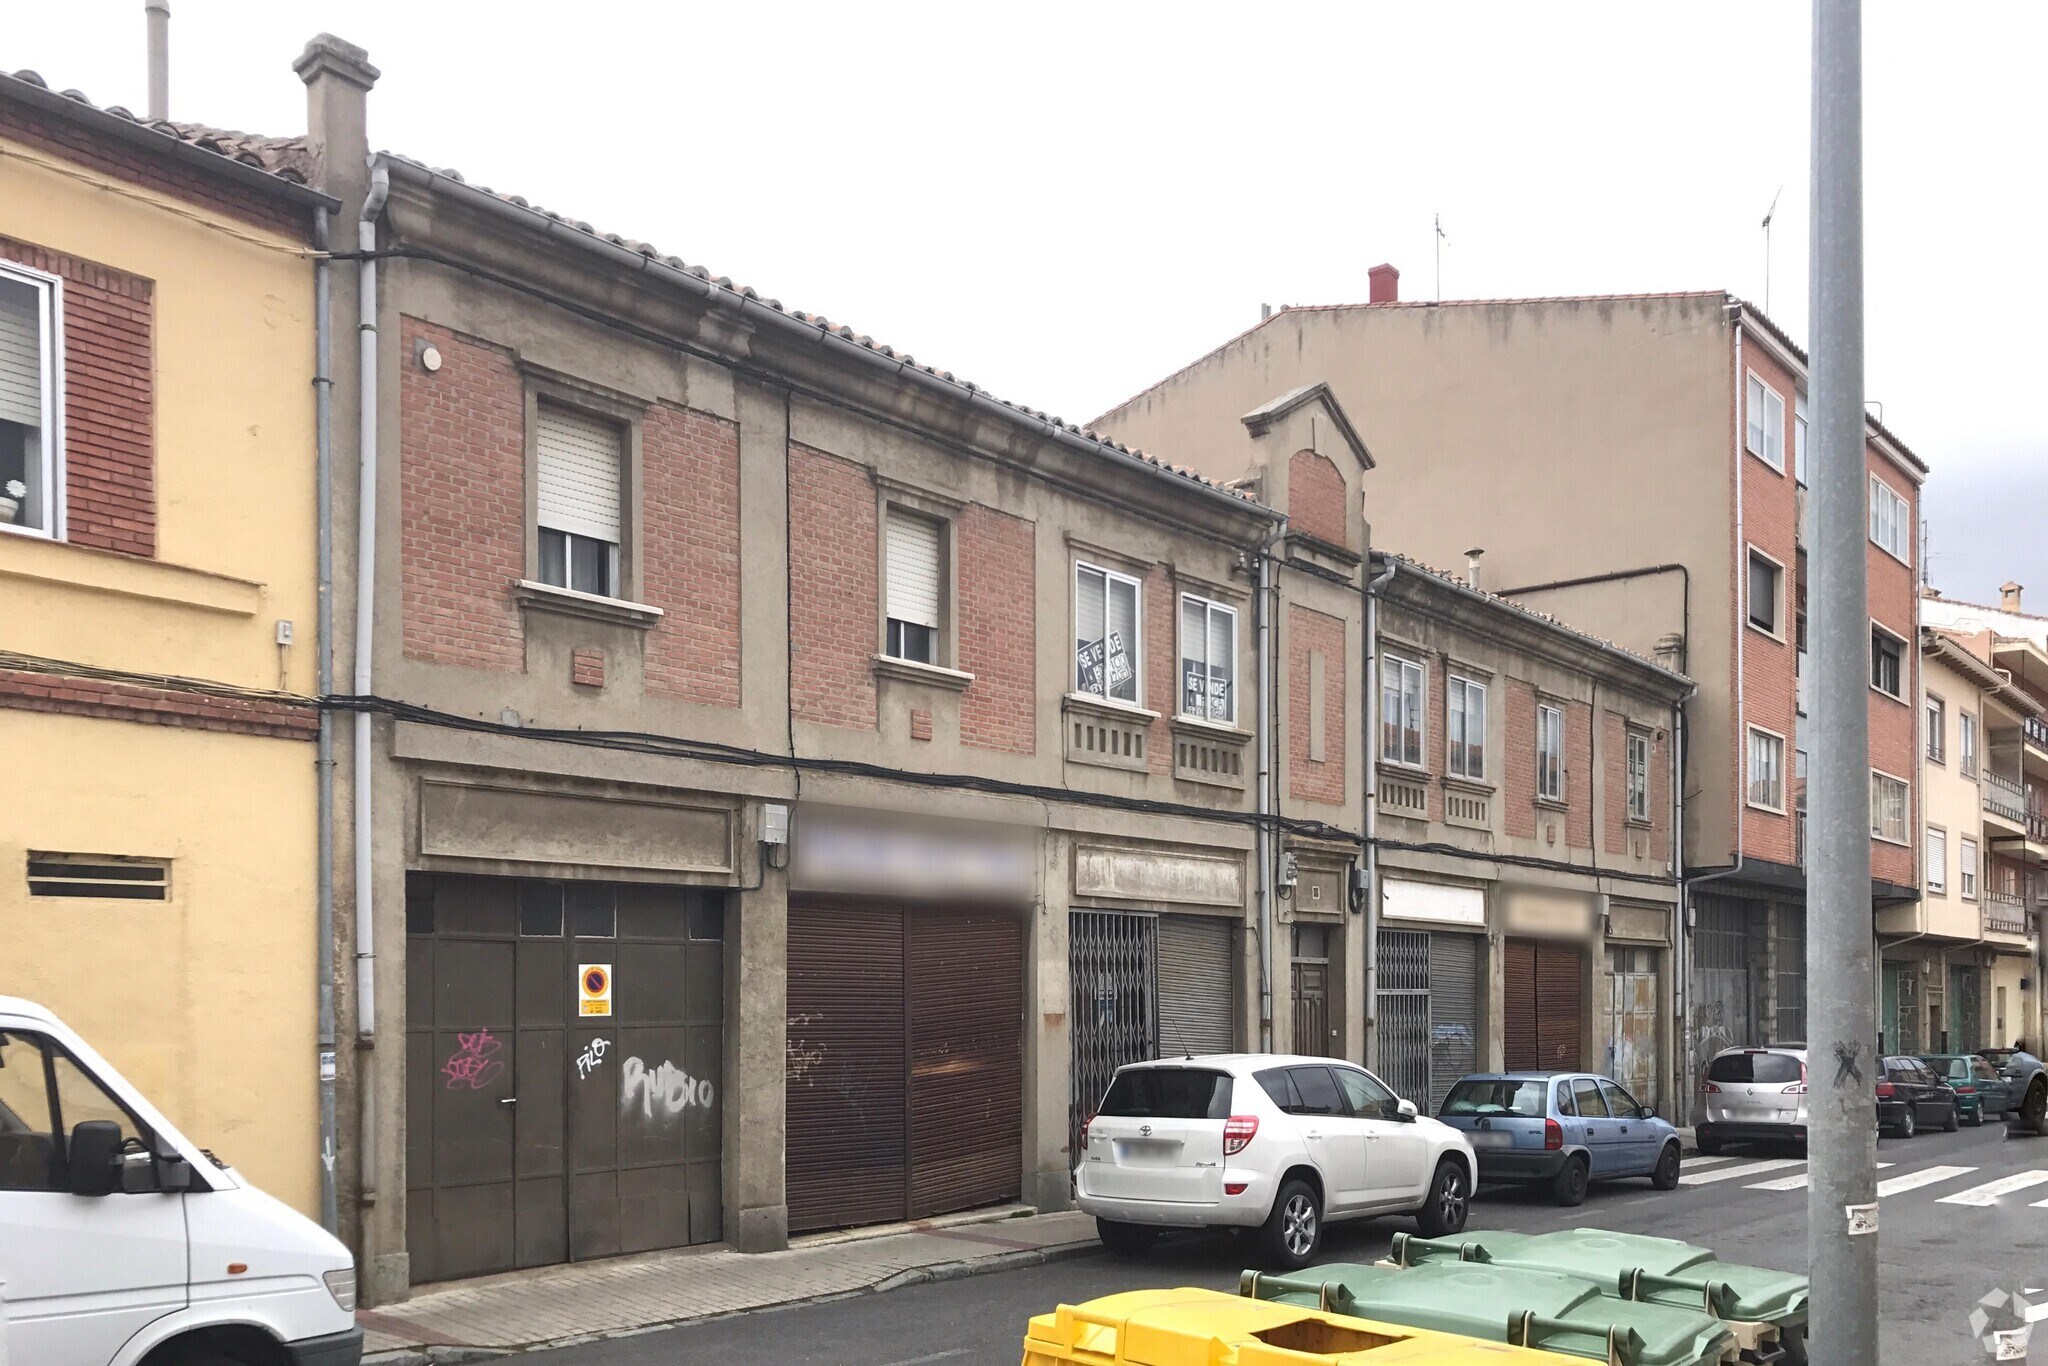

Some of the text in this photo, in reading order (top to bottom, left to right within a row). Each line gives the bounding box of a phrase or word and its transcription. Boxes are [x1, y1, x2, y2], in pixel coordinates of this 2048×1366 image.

[1079, 651, 1092, 668] SE
[1090, 635, 1122, 662] VEDE
[1188, 676, 1225, 696] SE VNDE
